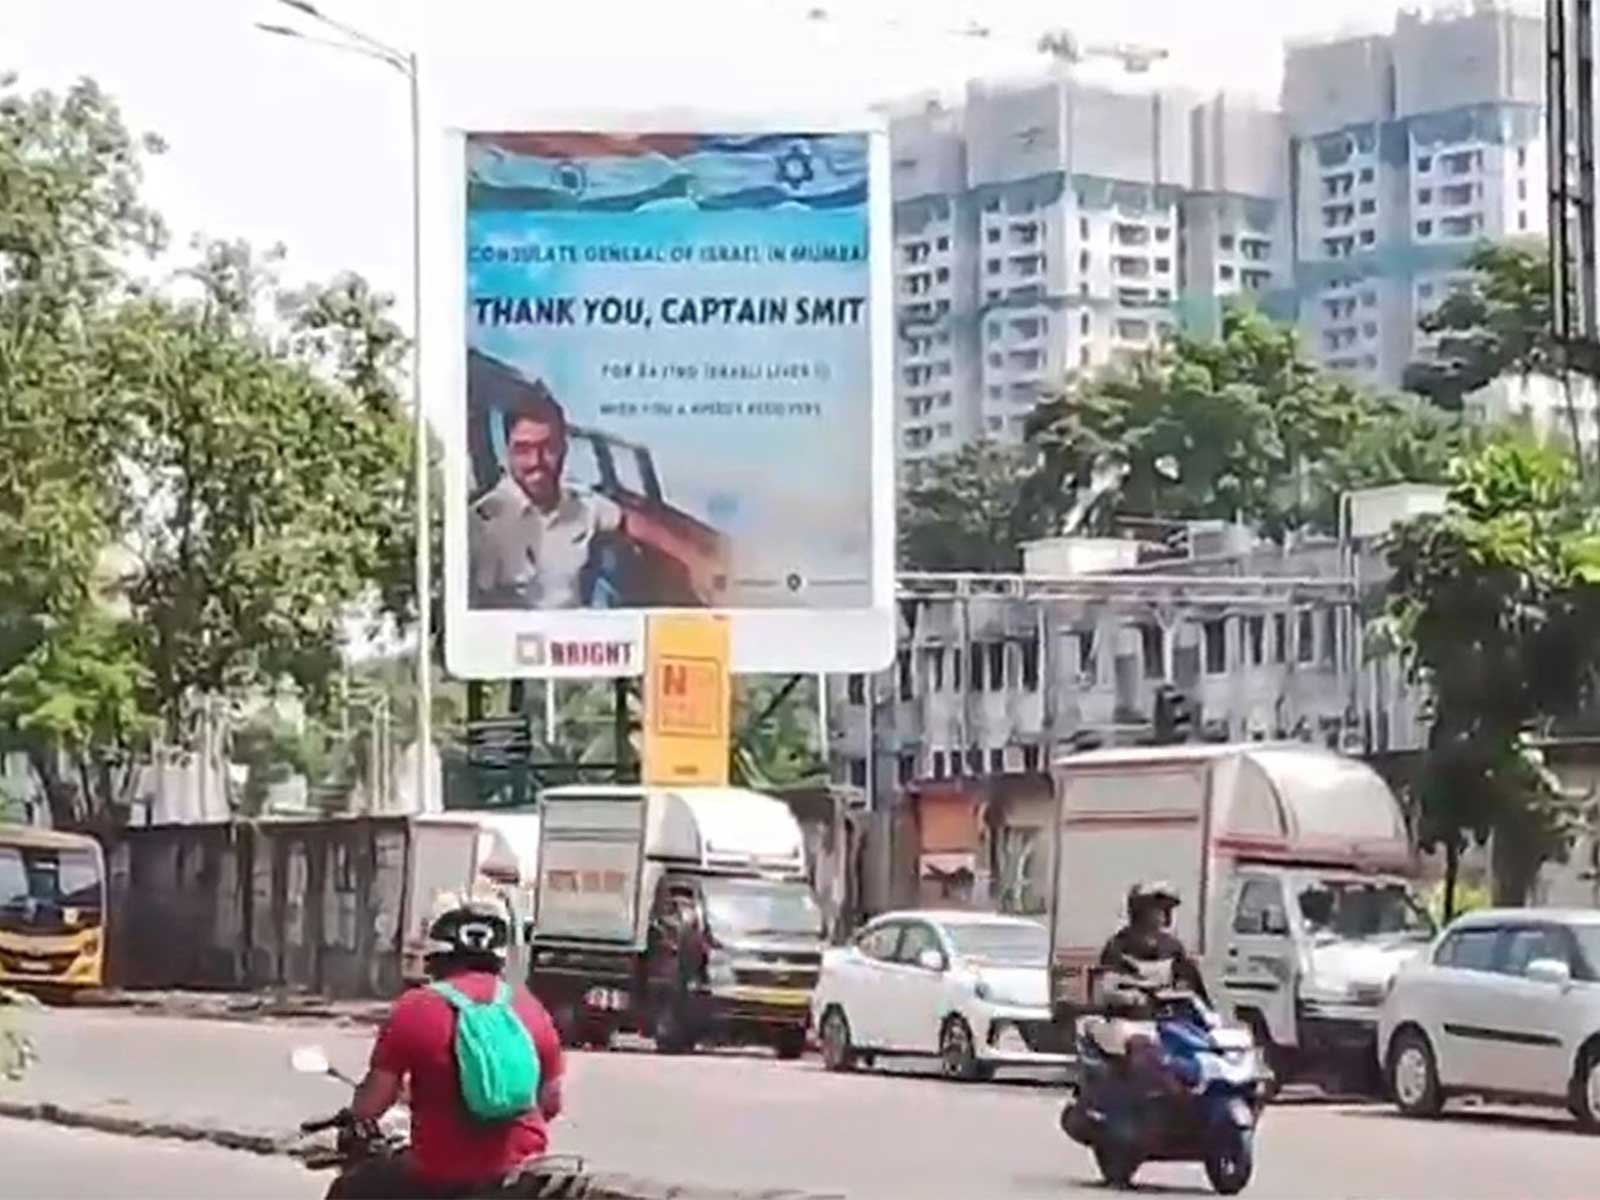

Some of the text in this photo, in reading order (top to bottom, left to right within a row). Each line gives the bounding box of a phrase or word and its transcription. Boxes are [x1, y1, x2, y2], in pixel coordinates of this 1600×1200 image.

[475, 297, 866, 328] THANK YOU, CAPTAIN SMIT
[551, 641, 633, 665] BRIGHT
